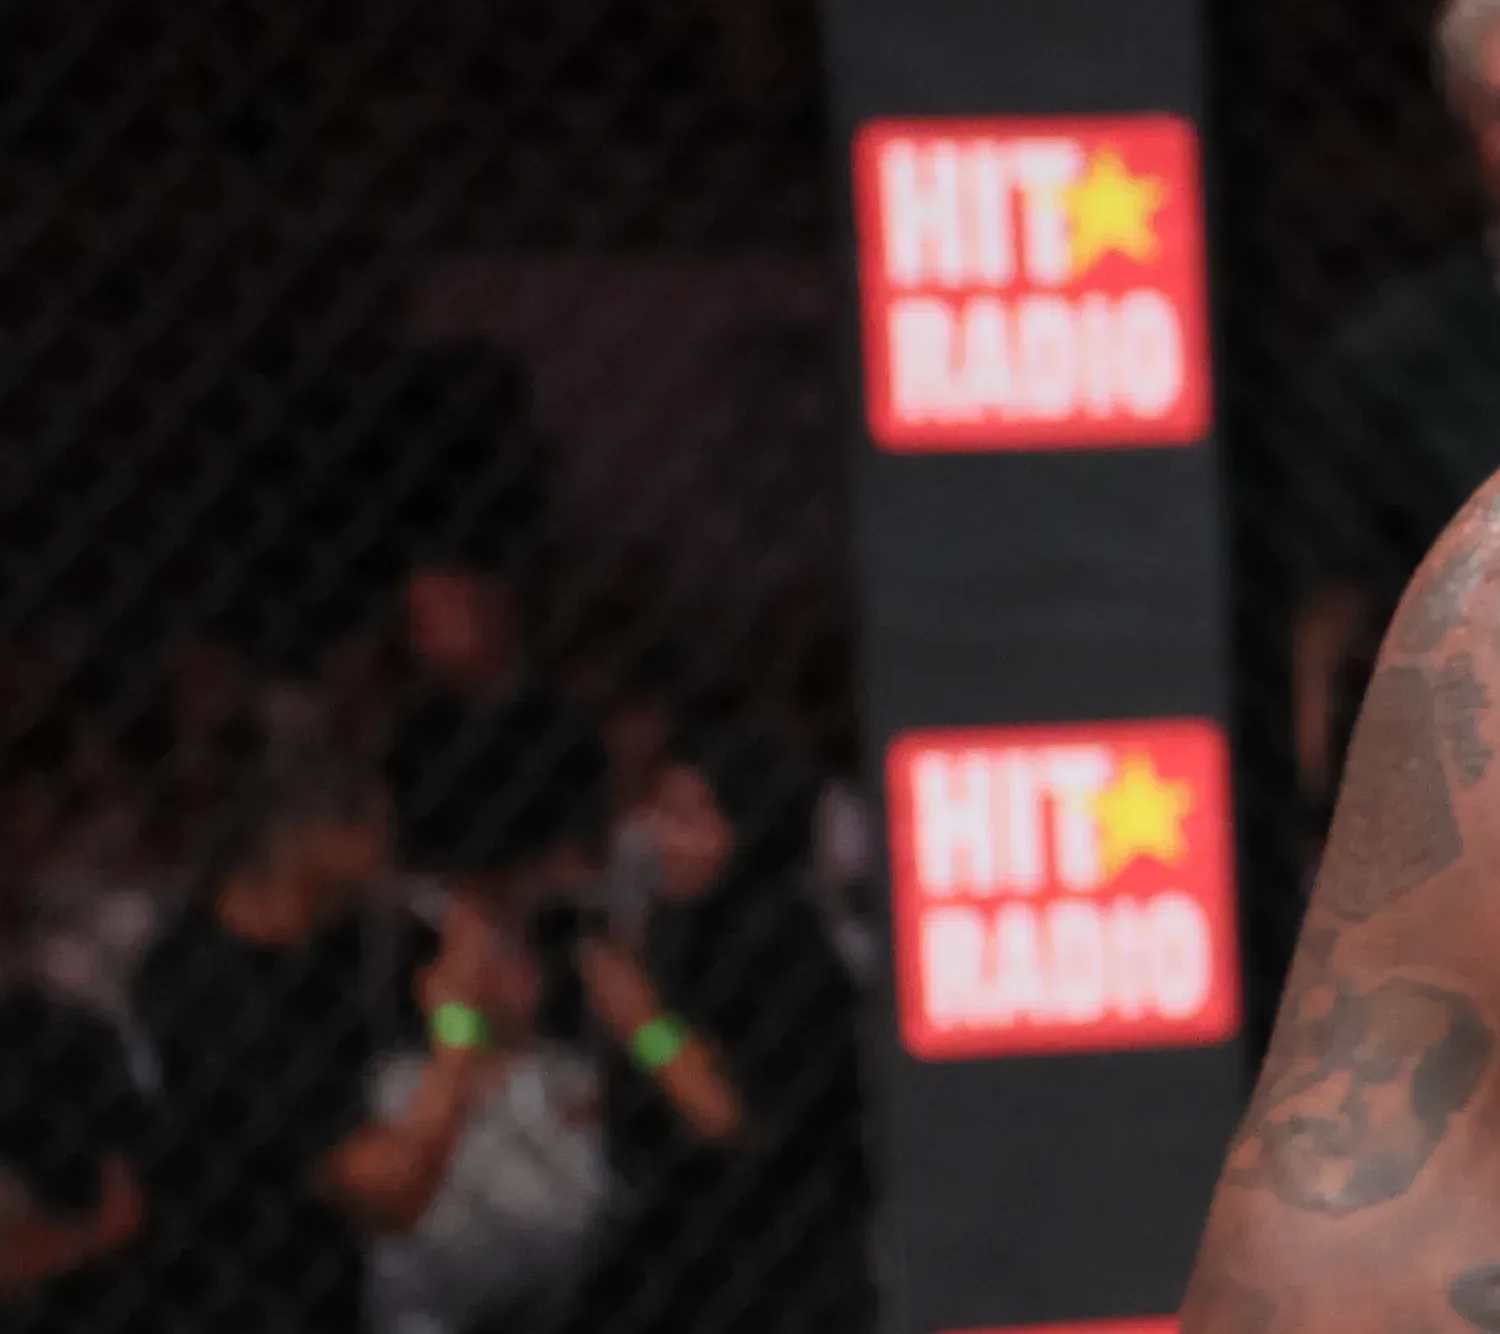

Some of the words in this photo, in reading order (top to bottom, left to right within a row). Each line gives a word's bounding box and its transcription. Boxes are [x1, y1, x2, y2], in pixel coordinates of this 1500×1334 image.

[880, 135, 1084, 289] HIT
[888, 289, 1184, 423] RADIO
[910, 743, 1113, 897] HIT
[920, 891, 1212, 1029] RADIO
